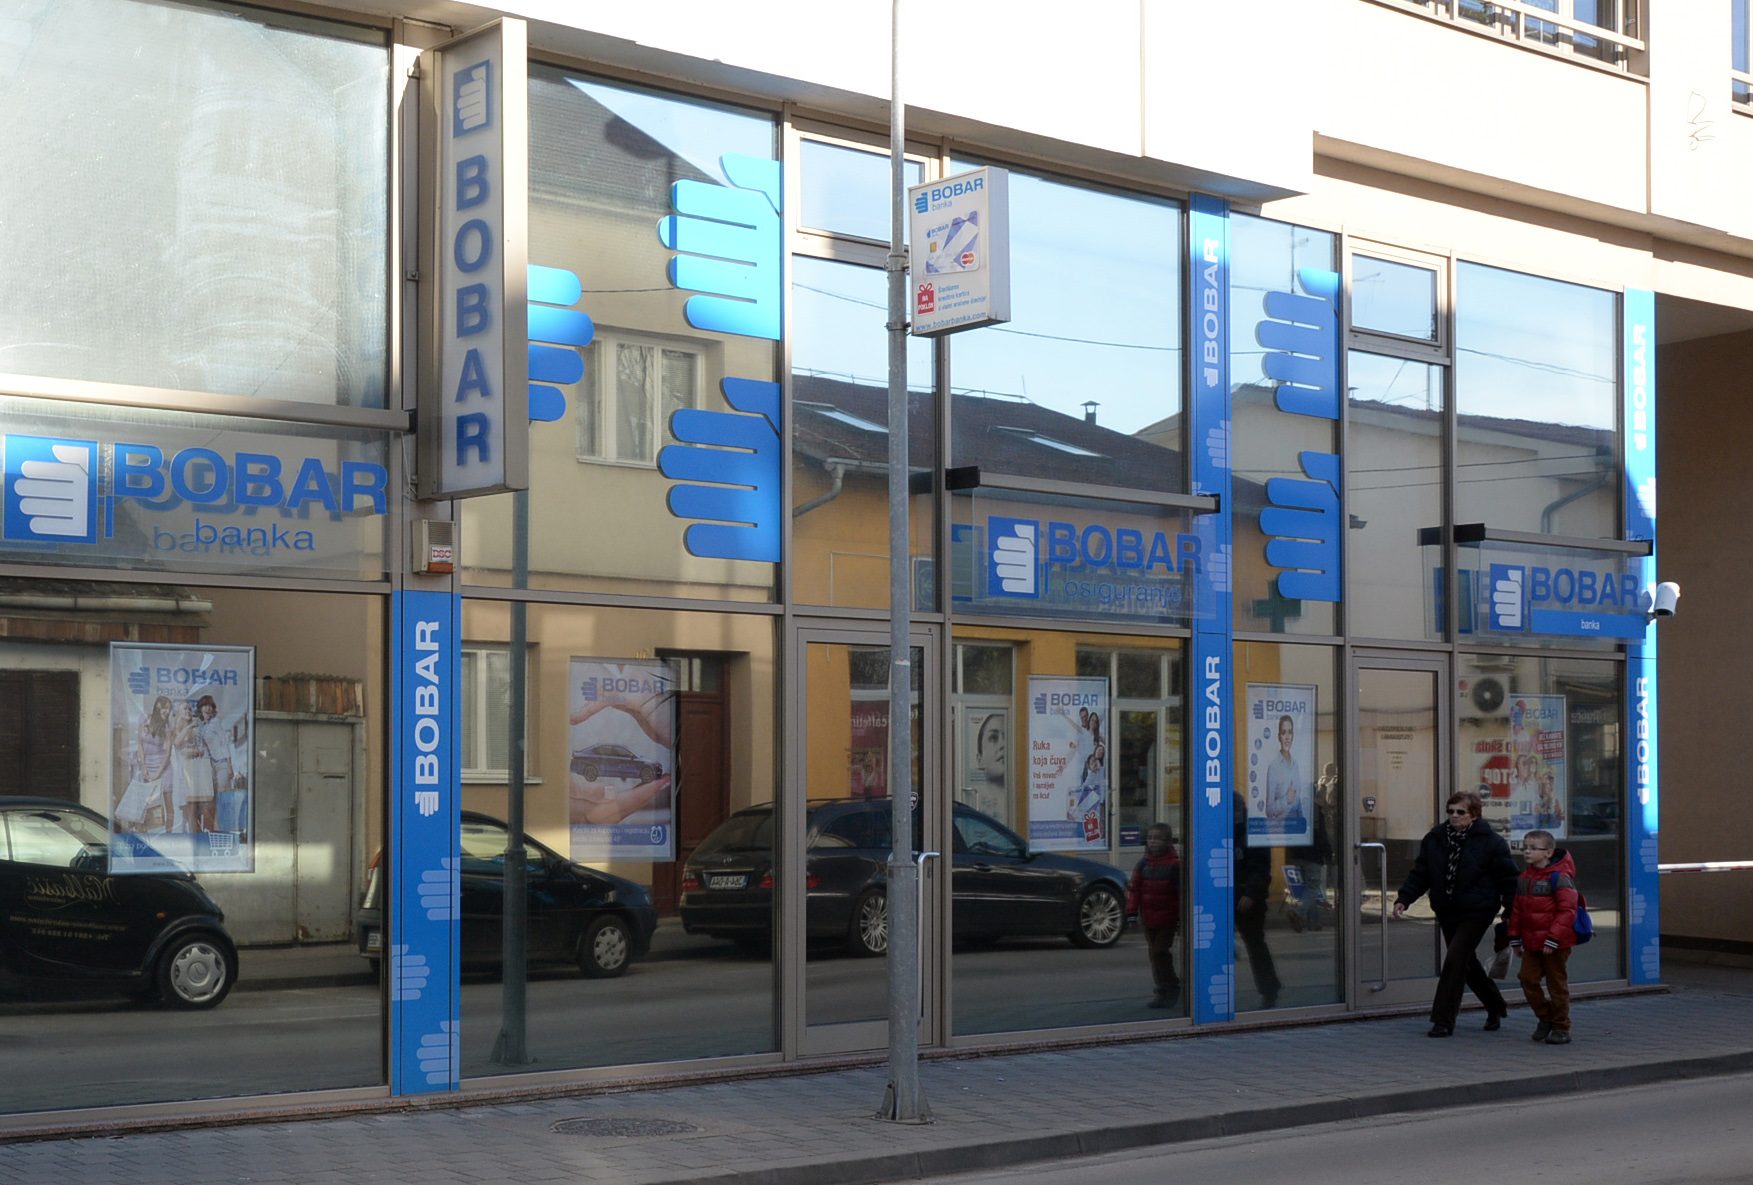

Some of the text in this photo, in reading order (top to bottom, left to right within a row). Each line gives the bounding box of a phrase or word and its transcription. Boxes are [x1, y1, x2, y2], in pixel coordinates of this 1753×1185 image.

[931, 177, 984, 202] BOBAR
[931, 200, 953, 212] banka
[453, 153, 493, 467] BOBAR
[1203, 238, 1220, 364] BOBAR
[916, 312, 987, 331] www.bobarbanka.com
[1632, 323, 1648, 431] BOBAR
[113, 442, 388, 515] BOBAR
[195, 518, 316, 552] banka
[432, 549, 452, 559] DSC
[1048, 521, 1203, 575] BOBAR
[1064, 580, 1183, 609] osiguranje
[1531, 566, 1639, 608] BOBAR
[1580, 619, 1600, 630] banka
[156, 666, 239, 686] BOBAR
[602, 677, 665, 694] BOBAR
[156, 686, 190, 697] banka
[414, 620, 440, 785] BOBAR
[1050, 693, 1099, 707] BOBAR
[1266, 700, 1306, 714] BOBAR
[1525, 708, 1558, 720] BOBAR
[1205, 656, 1221, 783] BOBAR
[1636, 676, 1650, 785] BOBAR
[1032, 740, 1051, 751] Ruka
[1032, 755, 1067, 767] koja čuva
